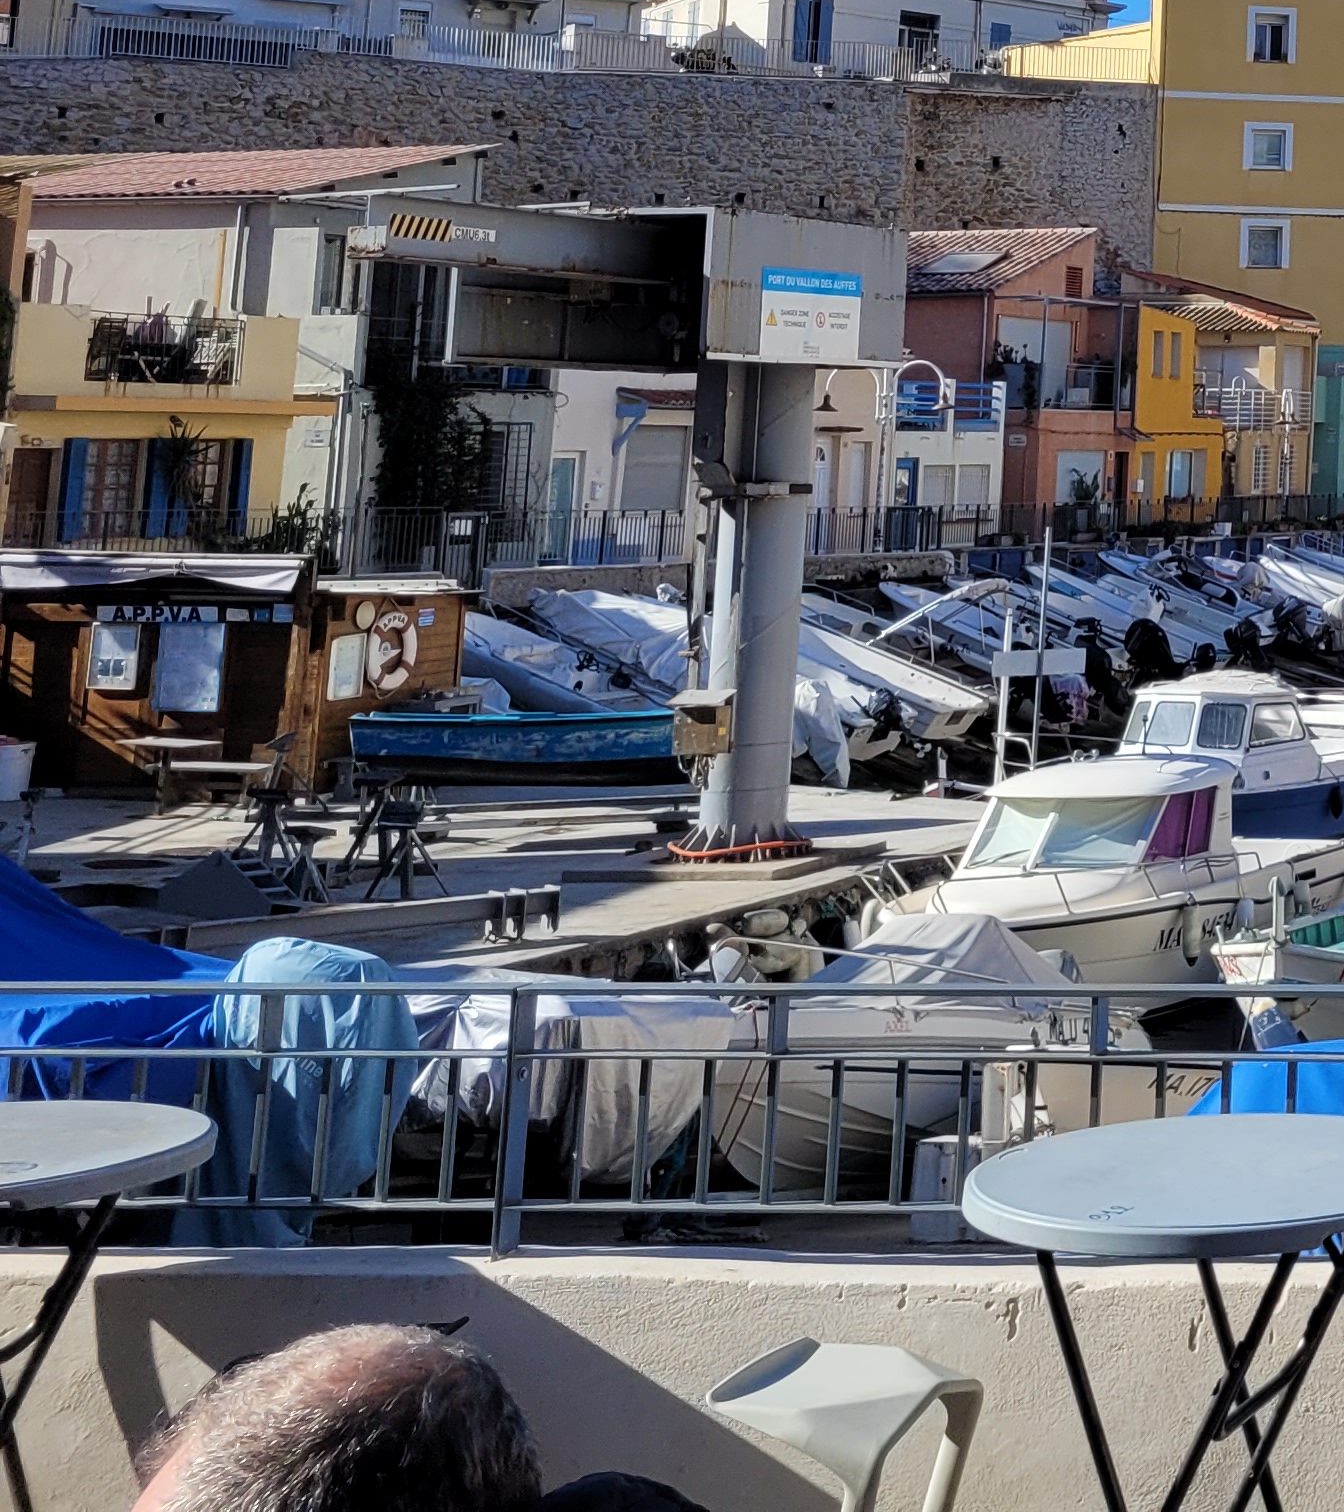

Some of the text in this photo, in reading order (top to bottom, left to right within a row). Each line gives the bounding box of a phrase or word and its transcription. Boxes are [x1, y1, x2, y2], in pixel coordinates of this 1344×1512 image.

[767, 274, 857, 291] PORT DU VALLON DES AUFFES
